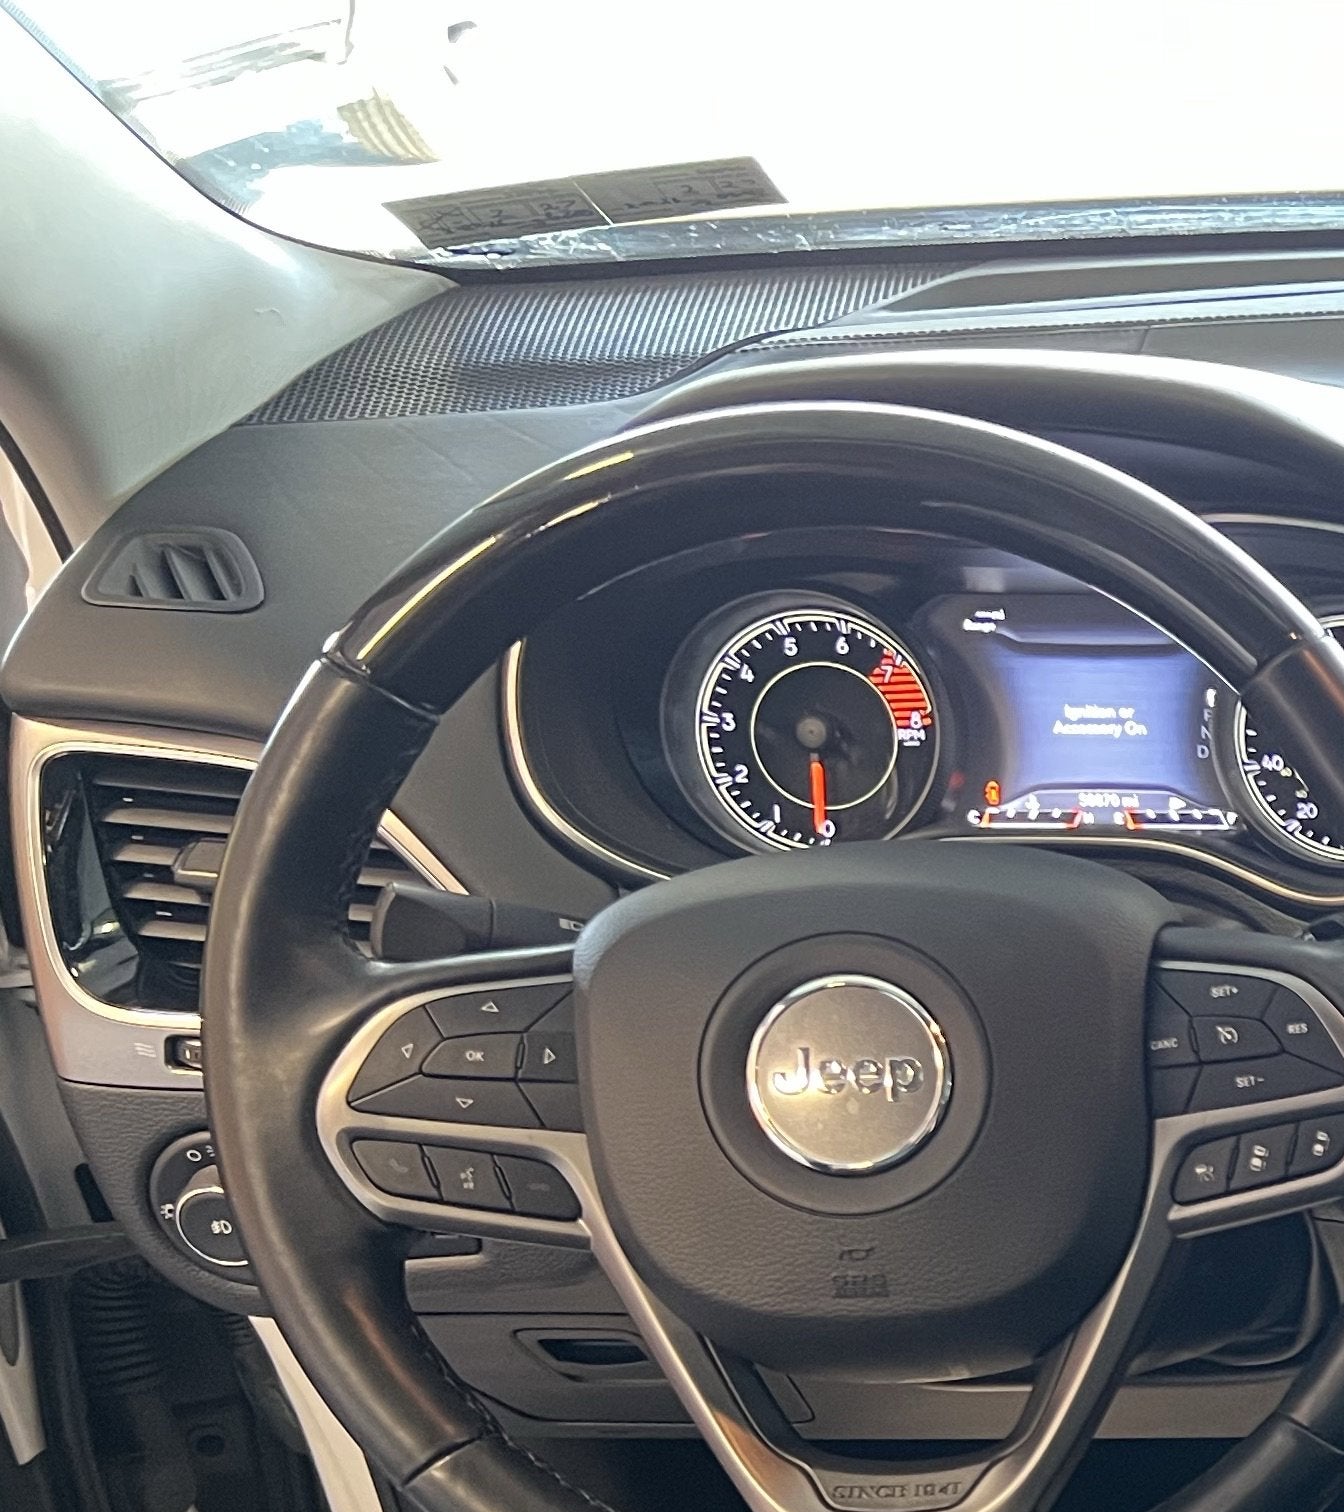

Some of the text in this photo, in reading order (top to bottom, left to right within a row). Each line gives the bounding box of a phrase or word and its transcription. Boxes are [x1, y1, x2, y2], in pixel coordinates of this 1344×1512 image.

[783, 638, 798, 657] 5
[836, 637, 850, 655] 6
[740, 664, 755, 684] 4
[880, 665, 893, 684] 7
[721, 712, 737, 731] 3
[909, 711, 923, 729] 8
[1124, 720, 1148, 736] On
[1197, 744, 1210, 759] D
[1261, 754, 1285, 772] 40
[733, 764, 750, 784] 2
[773, 803, 781, 823] 1
[1296, 802, 1319, 820] 20
[823, 818, 836, 838] 0
[1286, 1023, 1308, 1035] RES
[1151, 1037, 1178, 1050] CANC
[465, 1051, 485, 1062] OK
[772, 1047, 924, 1103] Jeep
[832, 1481, 962, 1500] SINCE 1941
